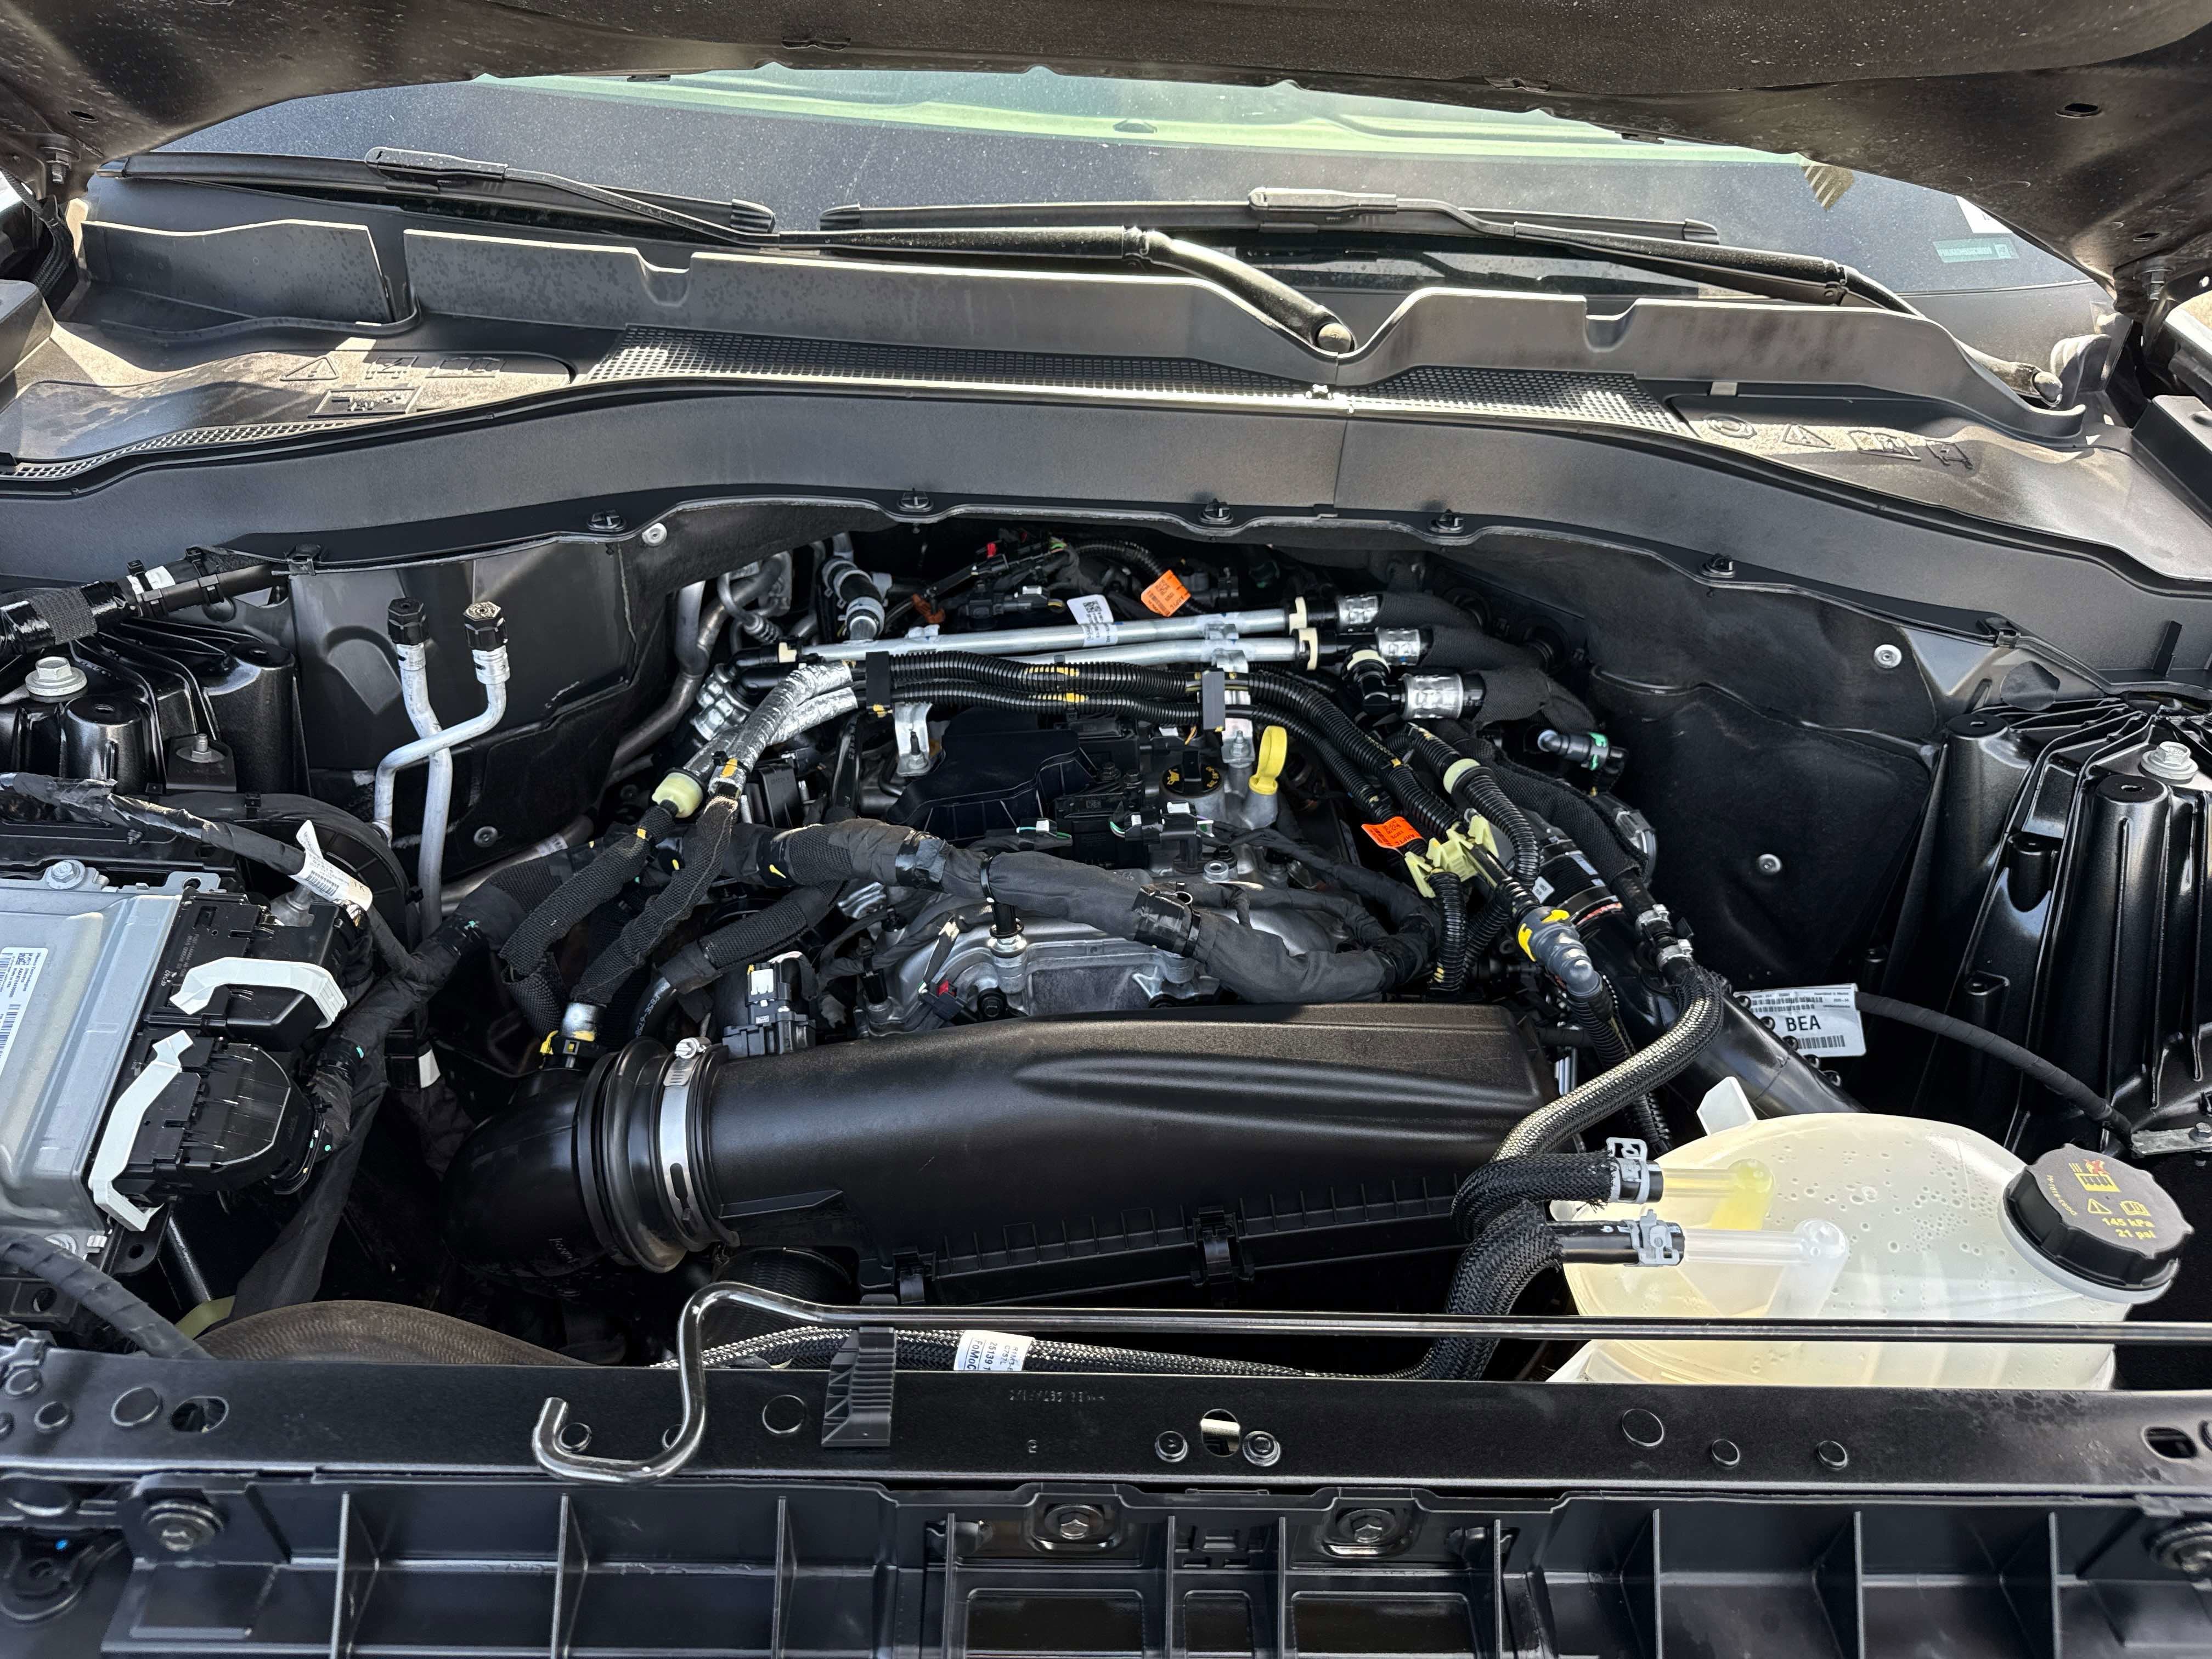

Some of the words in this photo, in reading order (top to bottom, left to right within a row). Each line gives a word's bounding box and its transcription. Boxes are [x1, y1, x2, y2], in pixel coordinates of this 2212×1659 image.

[1785, 1015, 1821, 1031] BEA
[2102, 1217, 2126, 1226] 145
[2127, 1218, 2155, 1228] kPa
[2115, 1228, 2133, 1238] 21
[2135, 1230, 2156, 1240] psi
